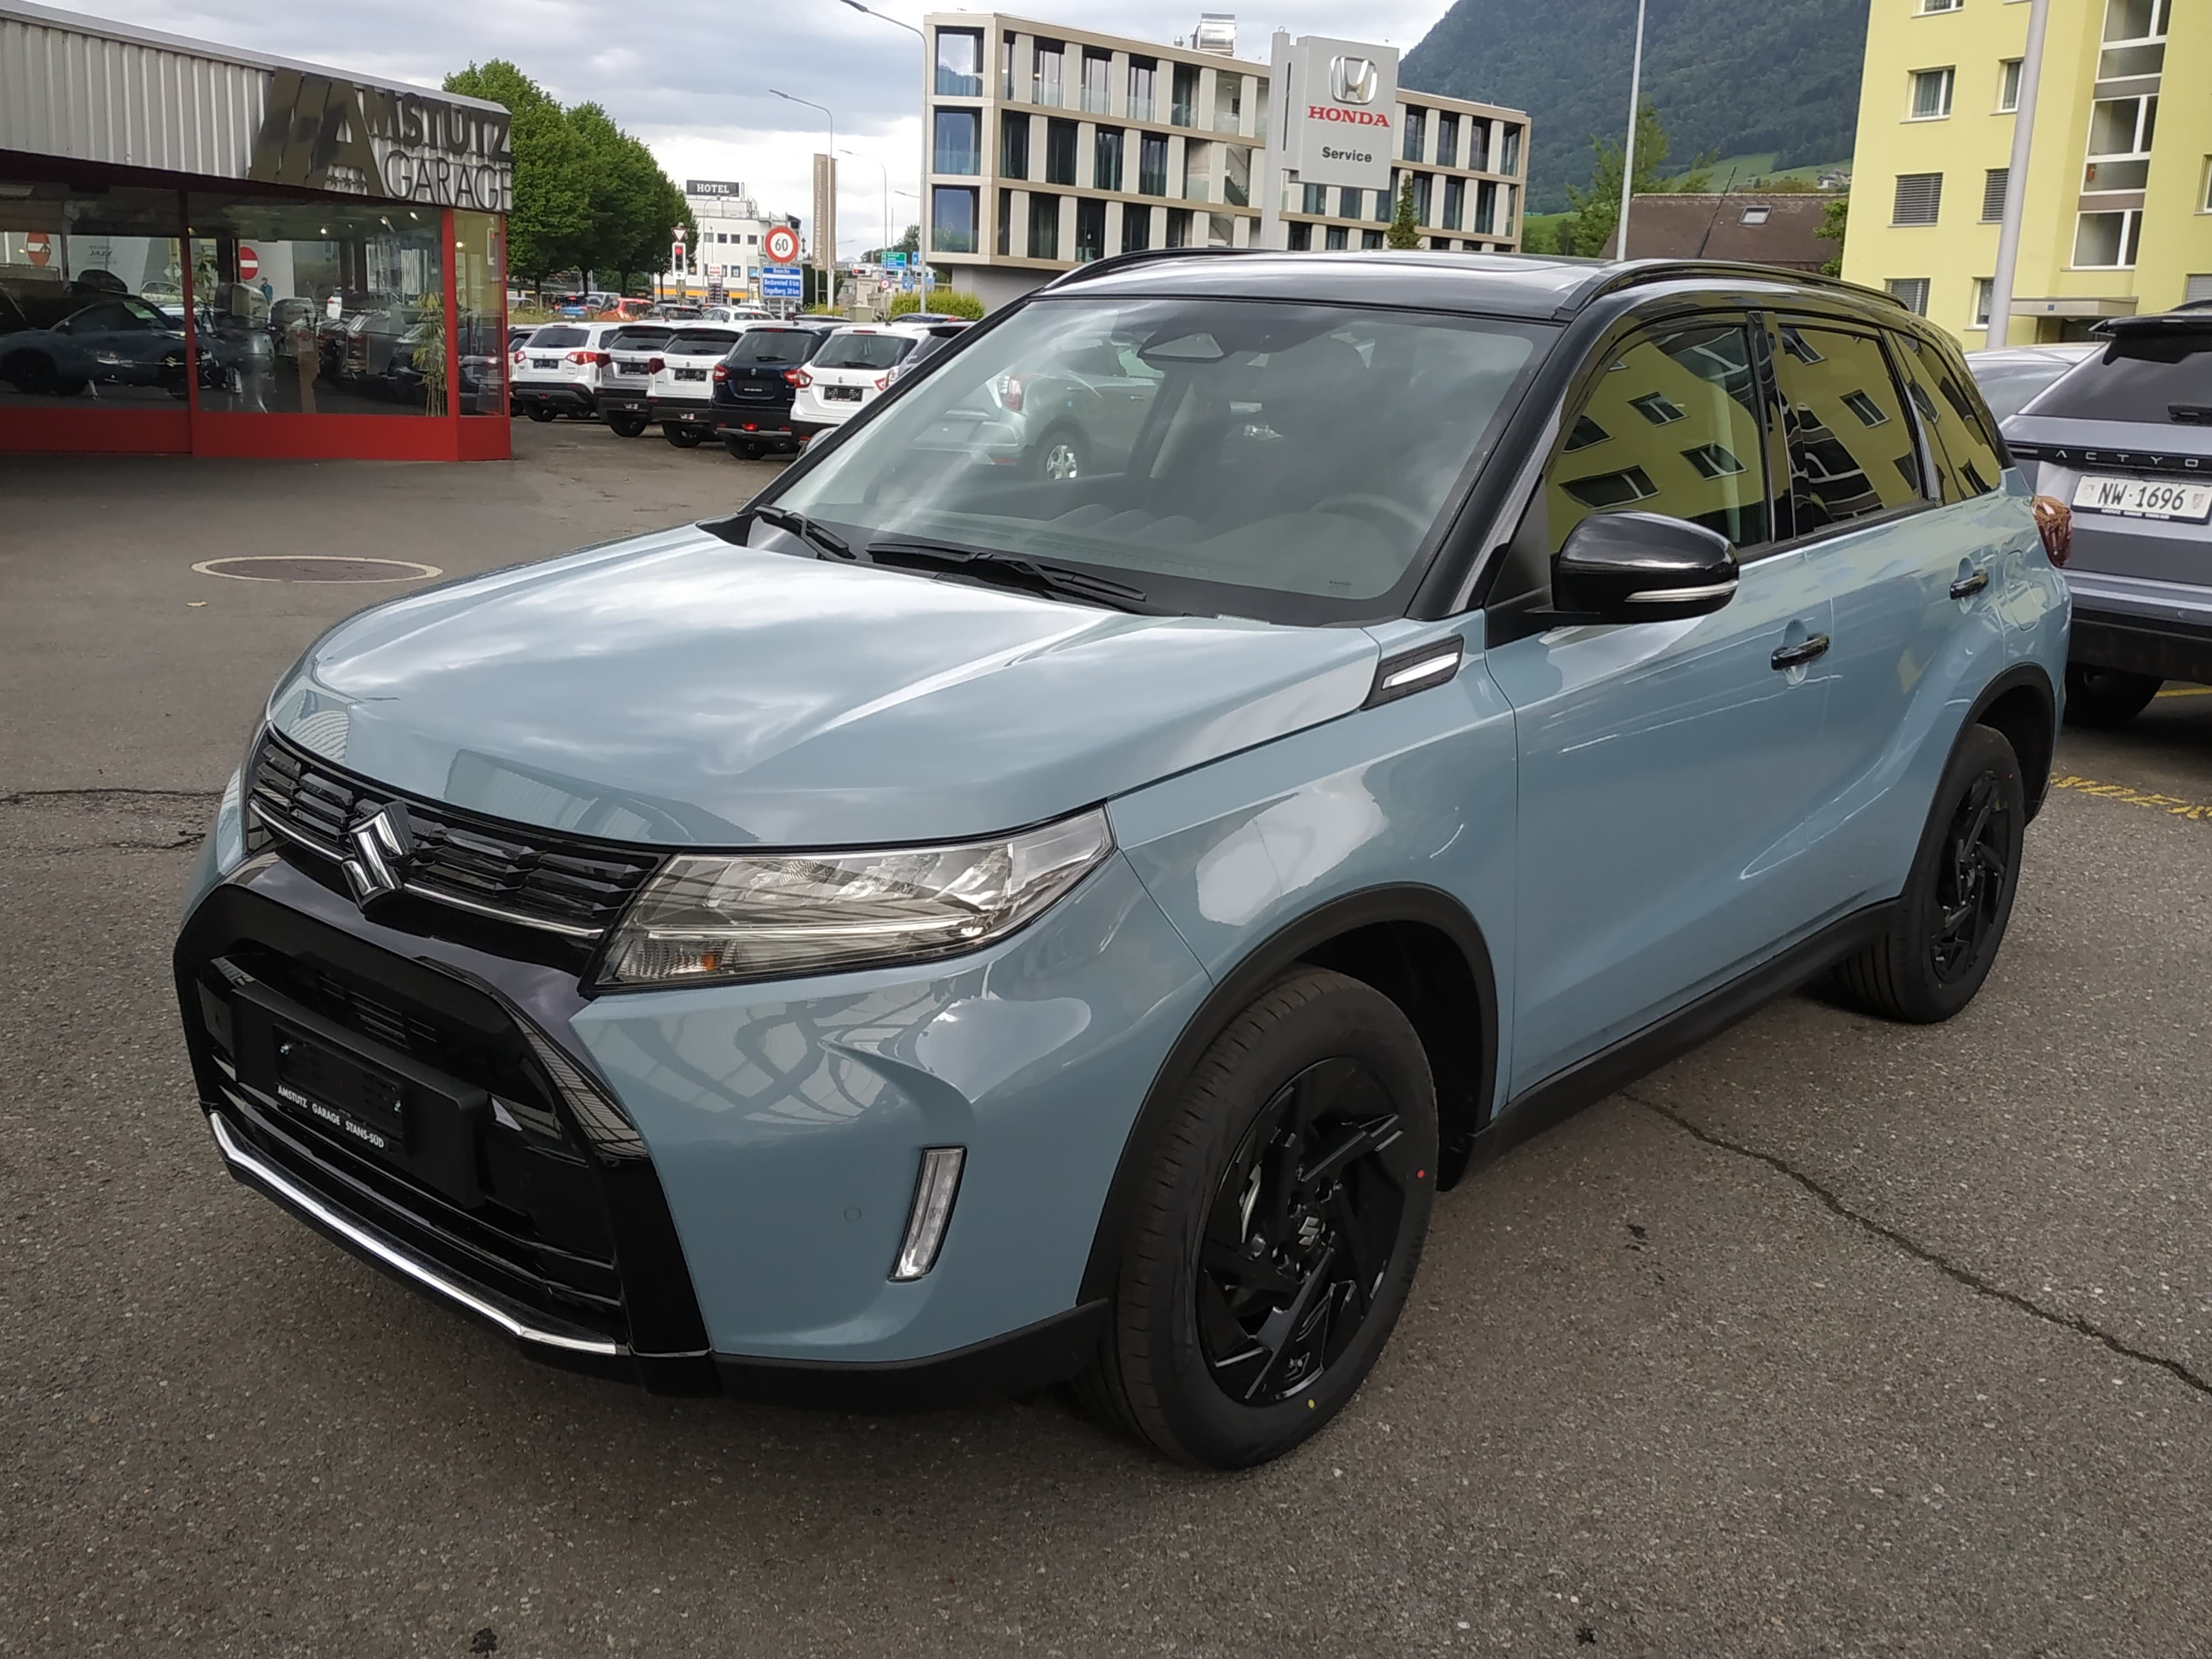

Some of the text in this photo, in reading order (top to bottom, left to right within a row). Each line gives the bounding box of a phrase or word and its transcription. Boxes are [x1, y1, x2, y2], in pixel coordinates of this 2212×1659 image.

[1308, 106, 1390, 127] HONDA
[1322, 146, 1372, 162] Service
[384, 149, 513, 213] GARAGE
[697, 184, 729, 193] HOTEL
[775, 238, 788, 251] 60
[764, 287, 786, 295] Engelberg
[278, 1086, 384, 1148] AMSTUTZ GARAGE STANS-SÜD
